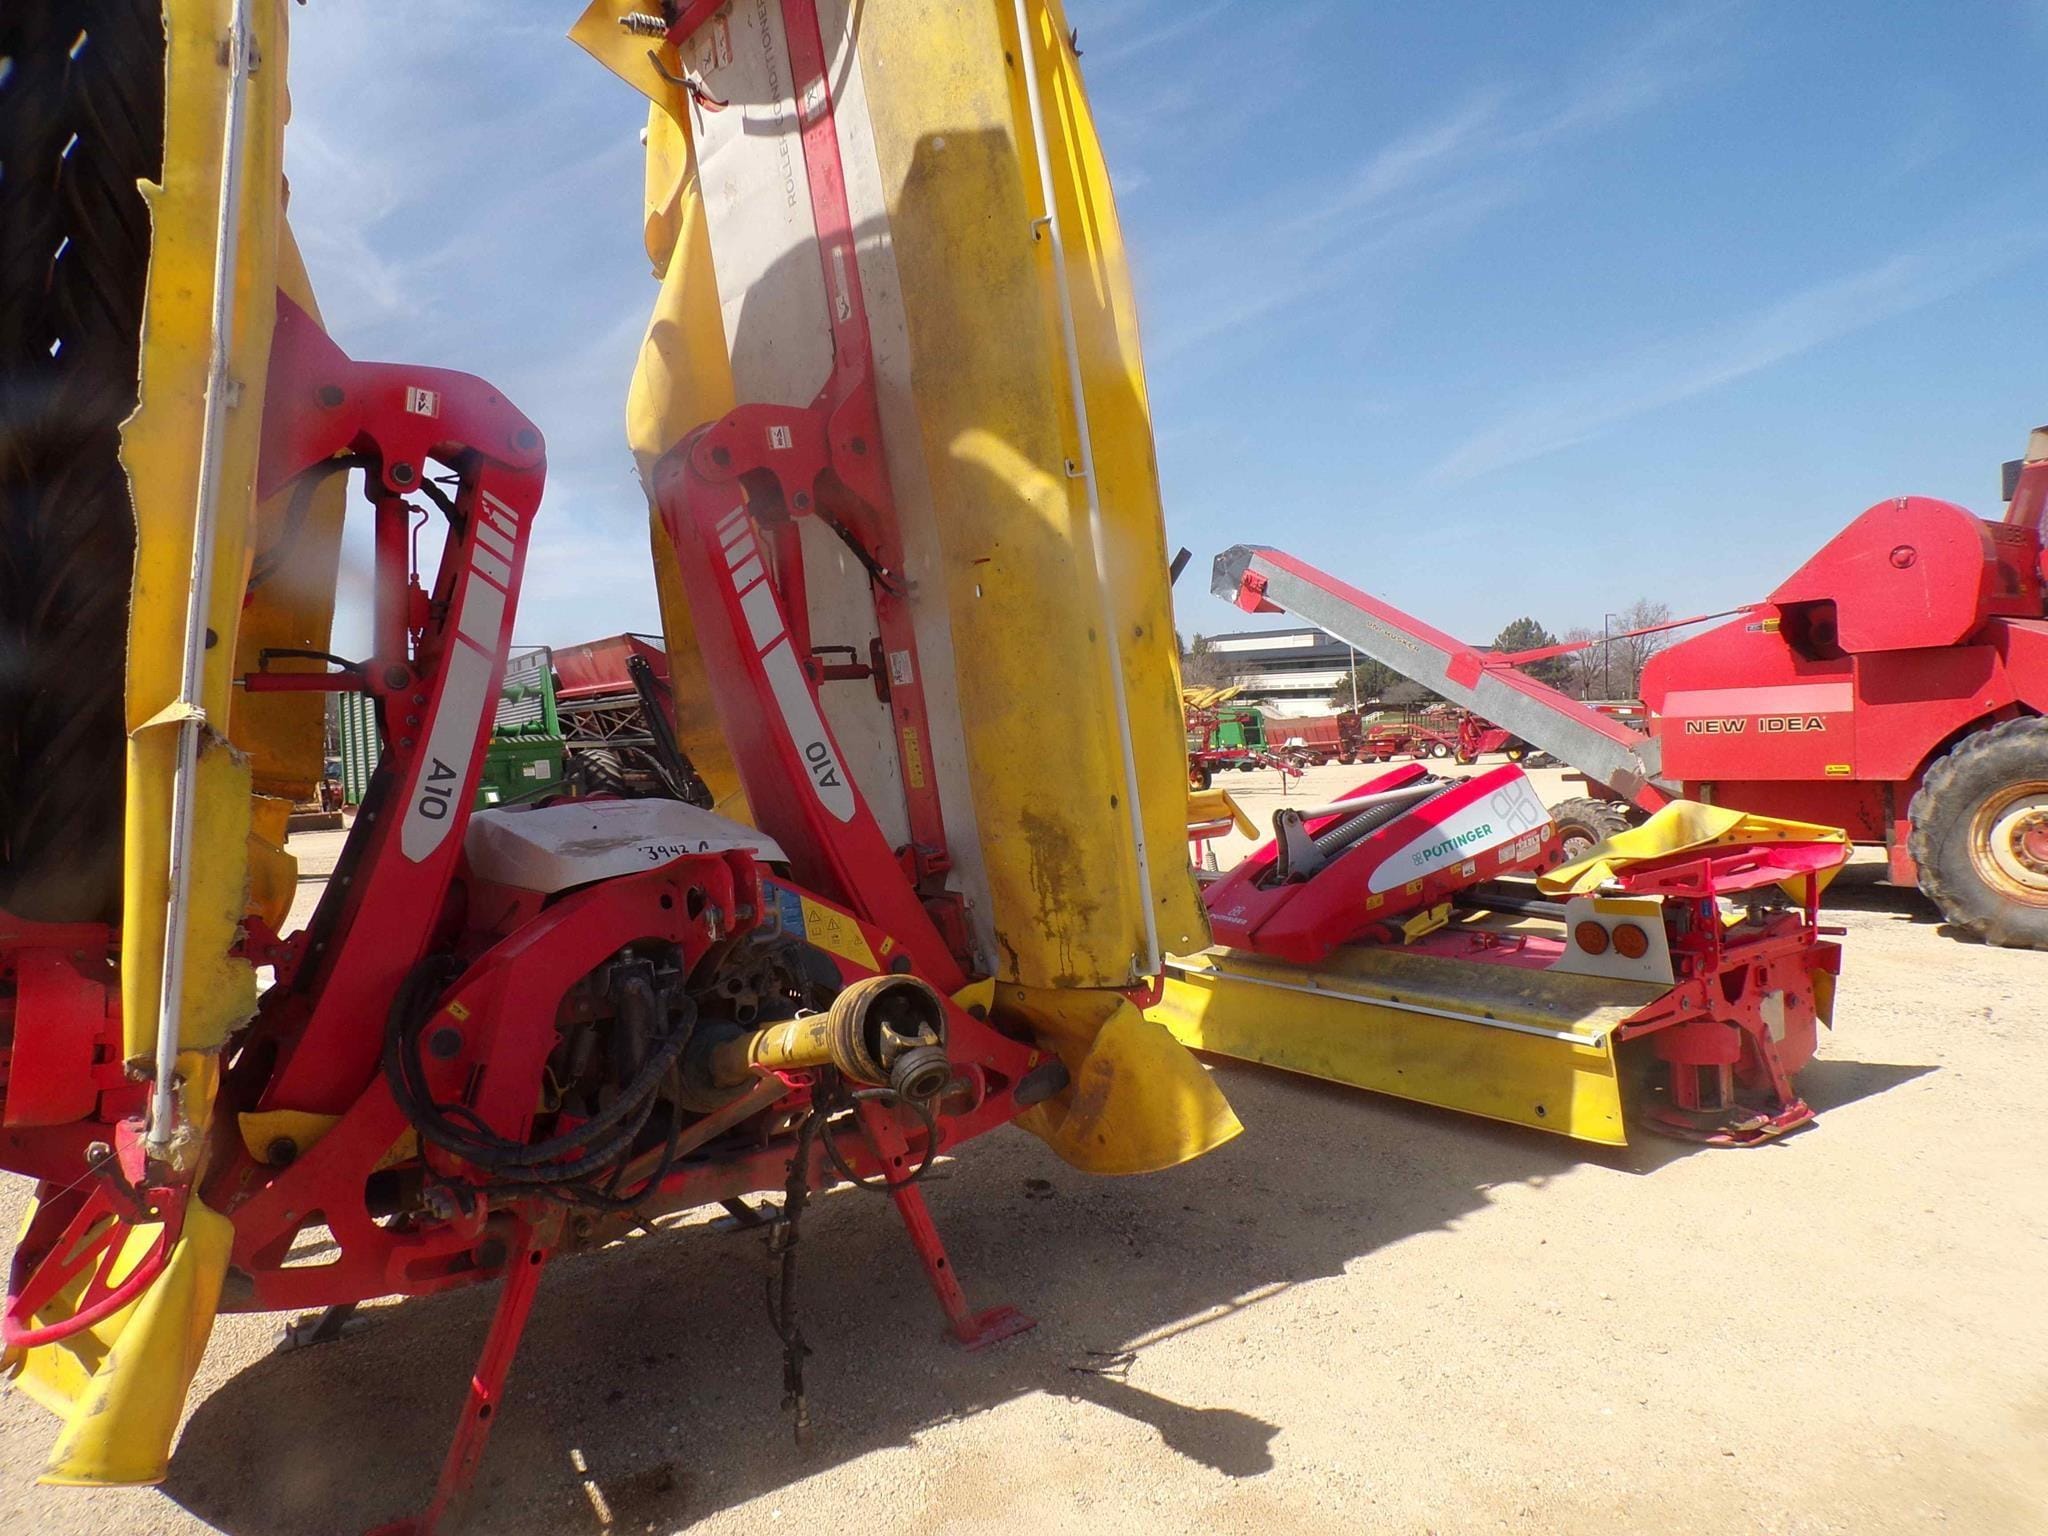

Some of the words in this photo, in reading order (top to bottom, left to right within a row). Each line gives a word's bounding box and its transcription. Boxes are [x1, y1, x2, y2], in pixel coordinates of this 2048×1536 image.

[778, 130, 797, 208] ROLLER
[1685, 717, 1747, 735] NEW
[1758, 715, 1826, 733] IDEA
[805, 741, 841, 787] A10
[418, 757, 457, 820] A10
[643, 844, 690, 861] 3942
